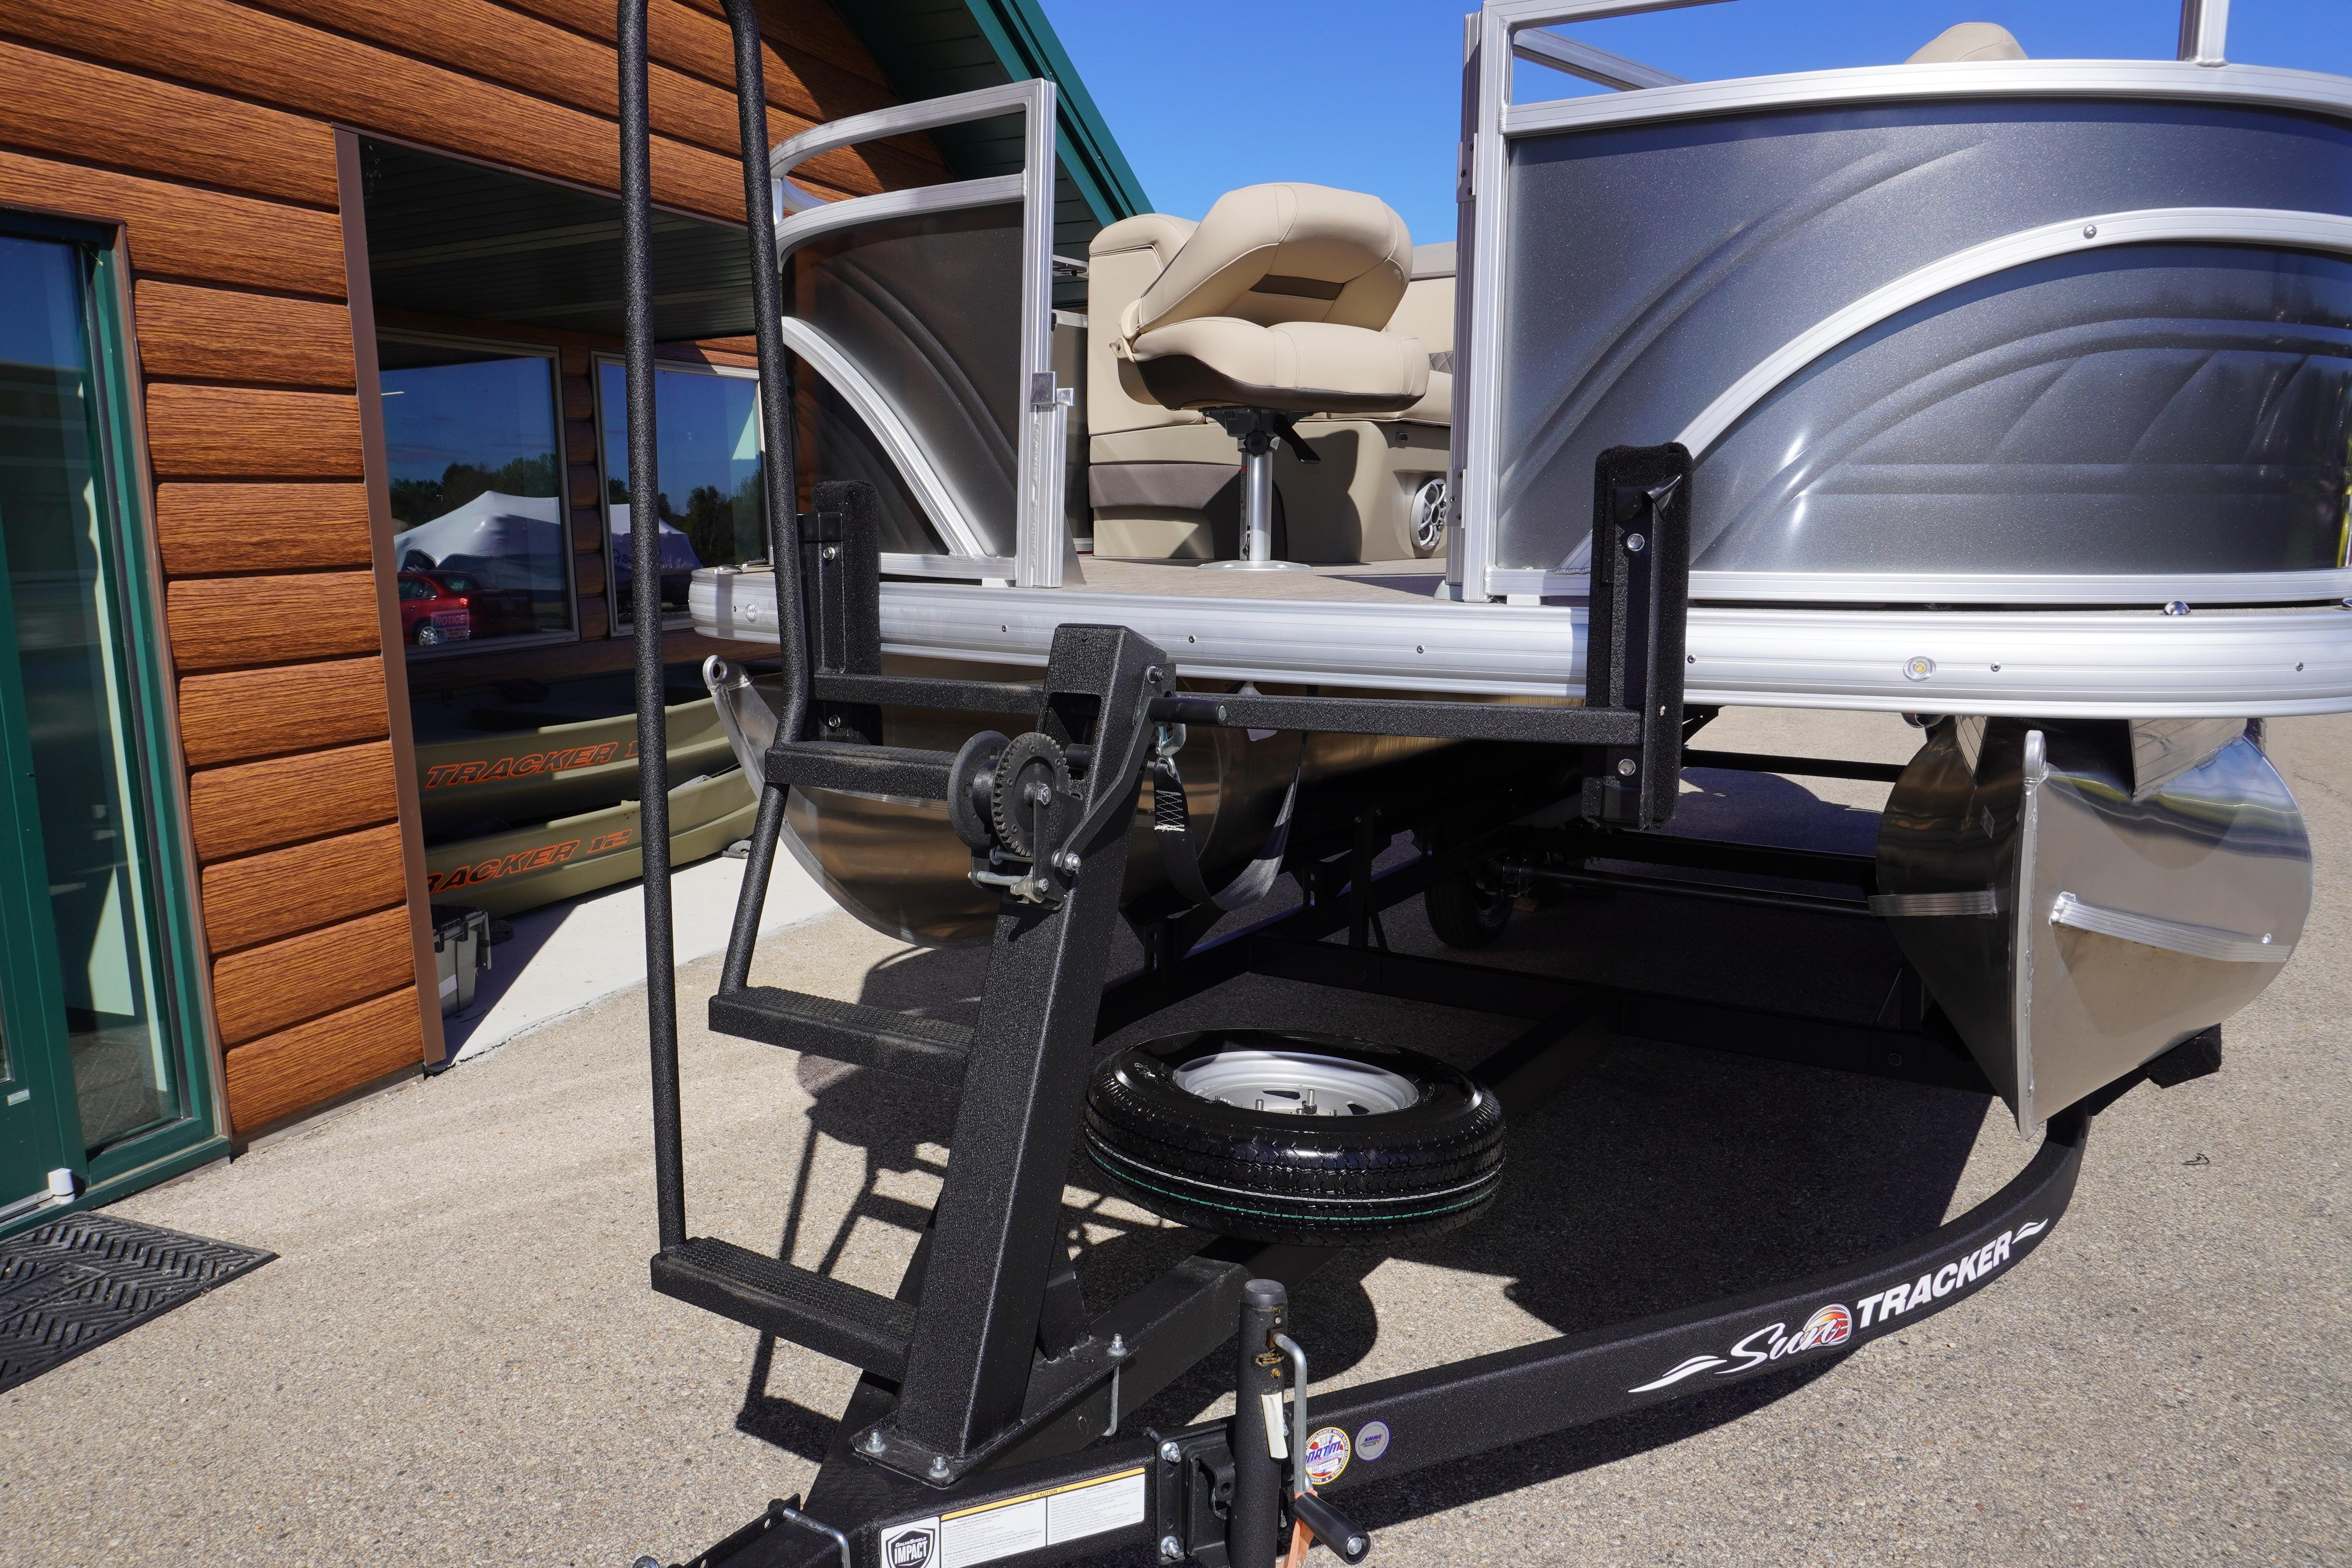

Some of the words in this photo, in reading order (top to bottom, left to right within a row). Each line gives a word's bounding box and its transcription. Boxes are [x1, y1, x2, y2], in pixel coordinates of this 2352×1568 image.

[434, 615, 465, 625] NOTICE
[425, 741, 619, 789] TRACKER
[587, 829, 633, 854] 12
[1714, 1318, 1842, 1374] Sun
[1857, 1230, 2012, 1329] TRACKER
[894, 1540, 928, 1564] IMPACT
